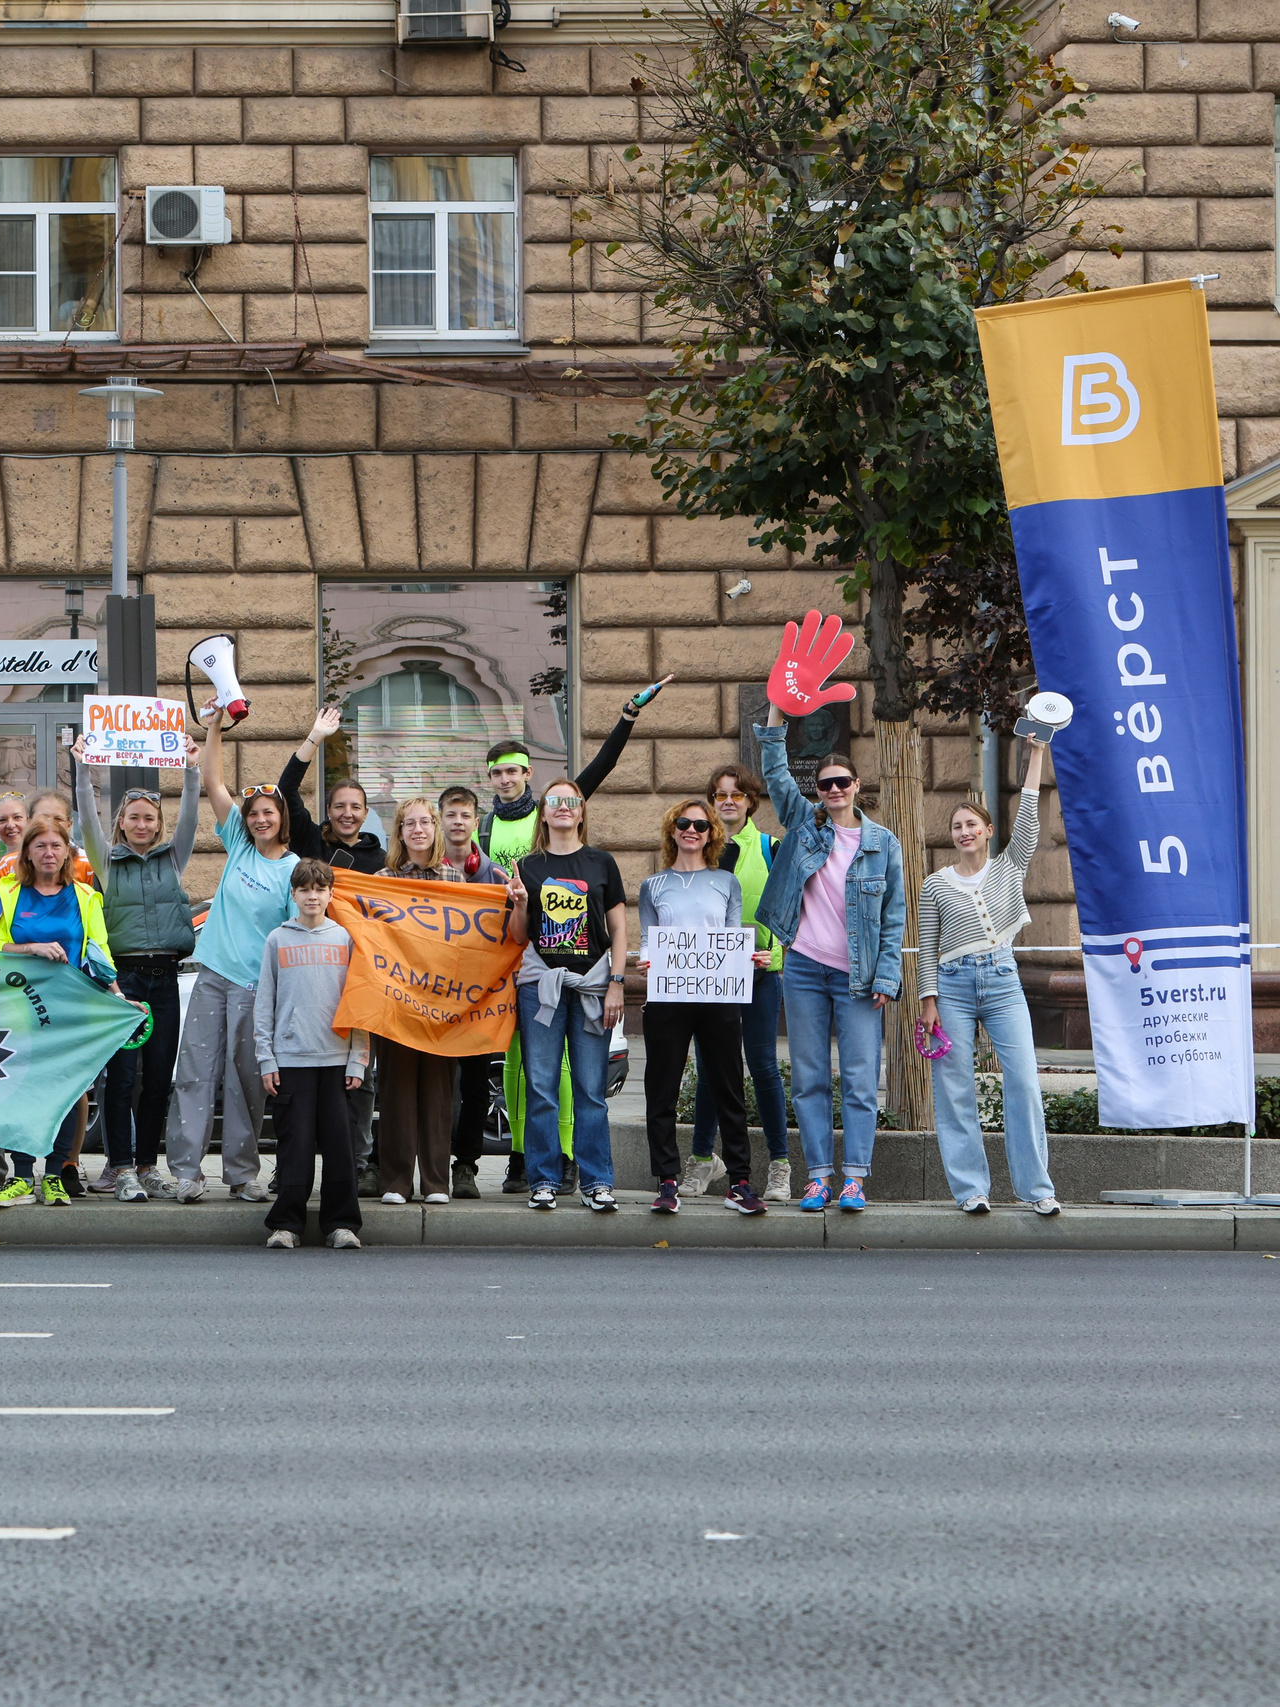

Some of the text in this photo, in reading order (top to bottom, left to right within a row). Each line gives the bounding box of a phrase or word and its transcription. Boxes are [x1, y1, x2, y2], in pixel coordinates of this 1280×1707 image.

[785, 660, 811, 704] 5 вёрст
[1098, 547, 1188, 877] 5 вёрст
[103, 730, 116, 748] 5
[546, 892, 585, 911] Bite
[657, 932, 745, 951] РАДИ ТЕБЯ
[286, 945, 340, 965] UNITED
[667, 952, 726, 970] МОСКВУ
[657, 976, 744, 996] ПЕРЕКРЫЛИ
[1140, 984, 1227, 1006] 5verst.ru
[1143, 1012, 1209, 1029] дружеские
[1145, 1030, 1208, 1047] пробежки
[1147, 1049, 1222, 1066] по субботам
